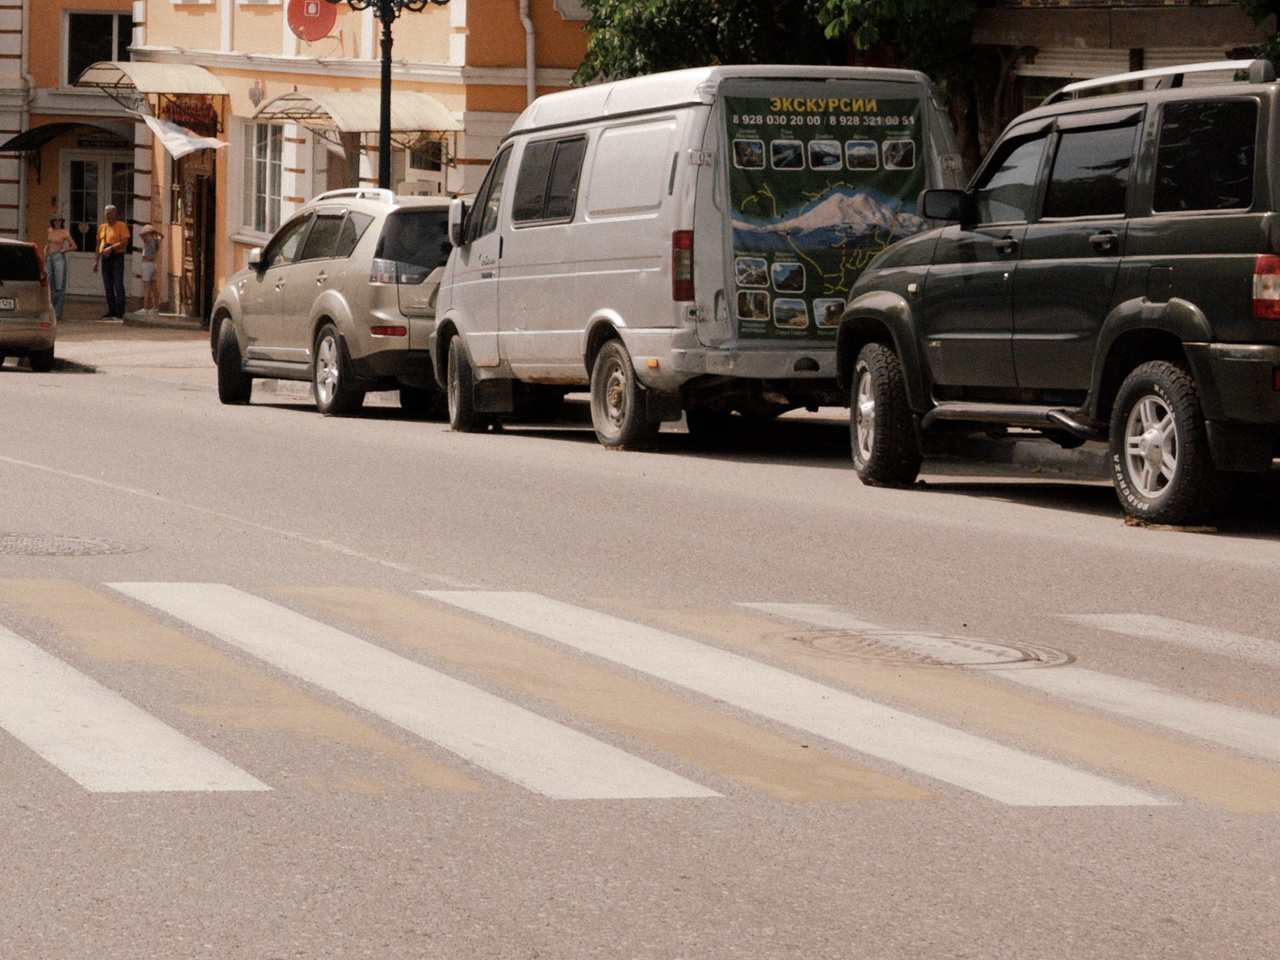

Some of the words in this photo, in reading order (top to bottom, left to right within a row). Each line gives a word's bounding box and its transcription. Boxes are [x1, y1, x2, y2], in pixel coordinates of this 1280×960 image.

[770, 97, 878, 113] ЭКСКУРСИИ
[732, 114, 740, 125] 8
[742, 114, 763, 125] 928
[766, 114, 787, 126] 030
[790, 115, 804, 126] 20
[807, 115, 821, 126] 00
[829, 115, 837, 126] 8
[839, 115, 861, 126] 928
[863, 115, 882, 126] 321
[885, 115, 900, 126] 00
[902, 115, 915, 126] 51
